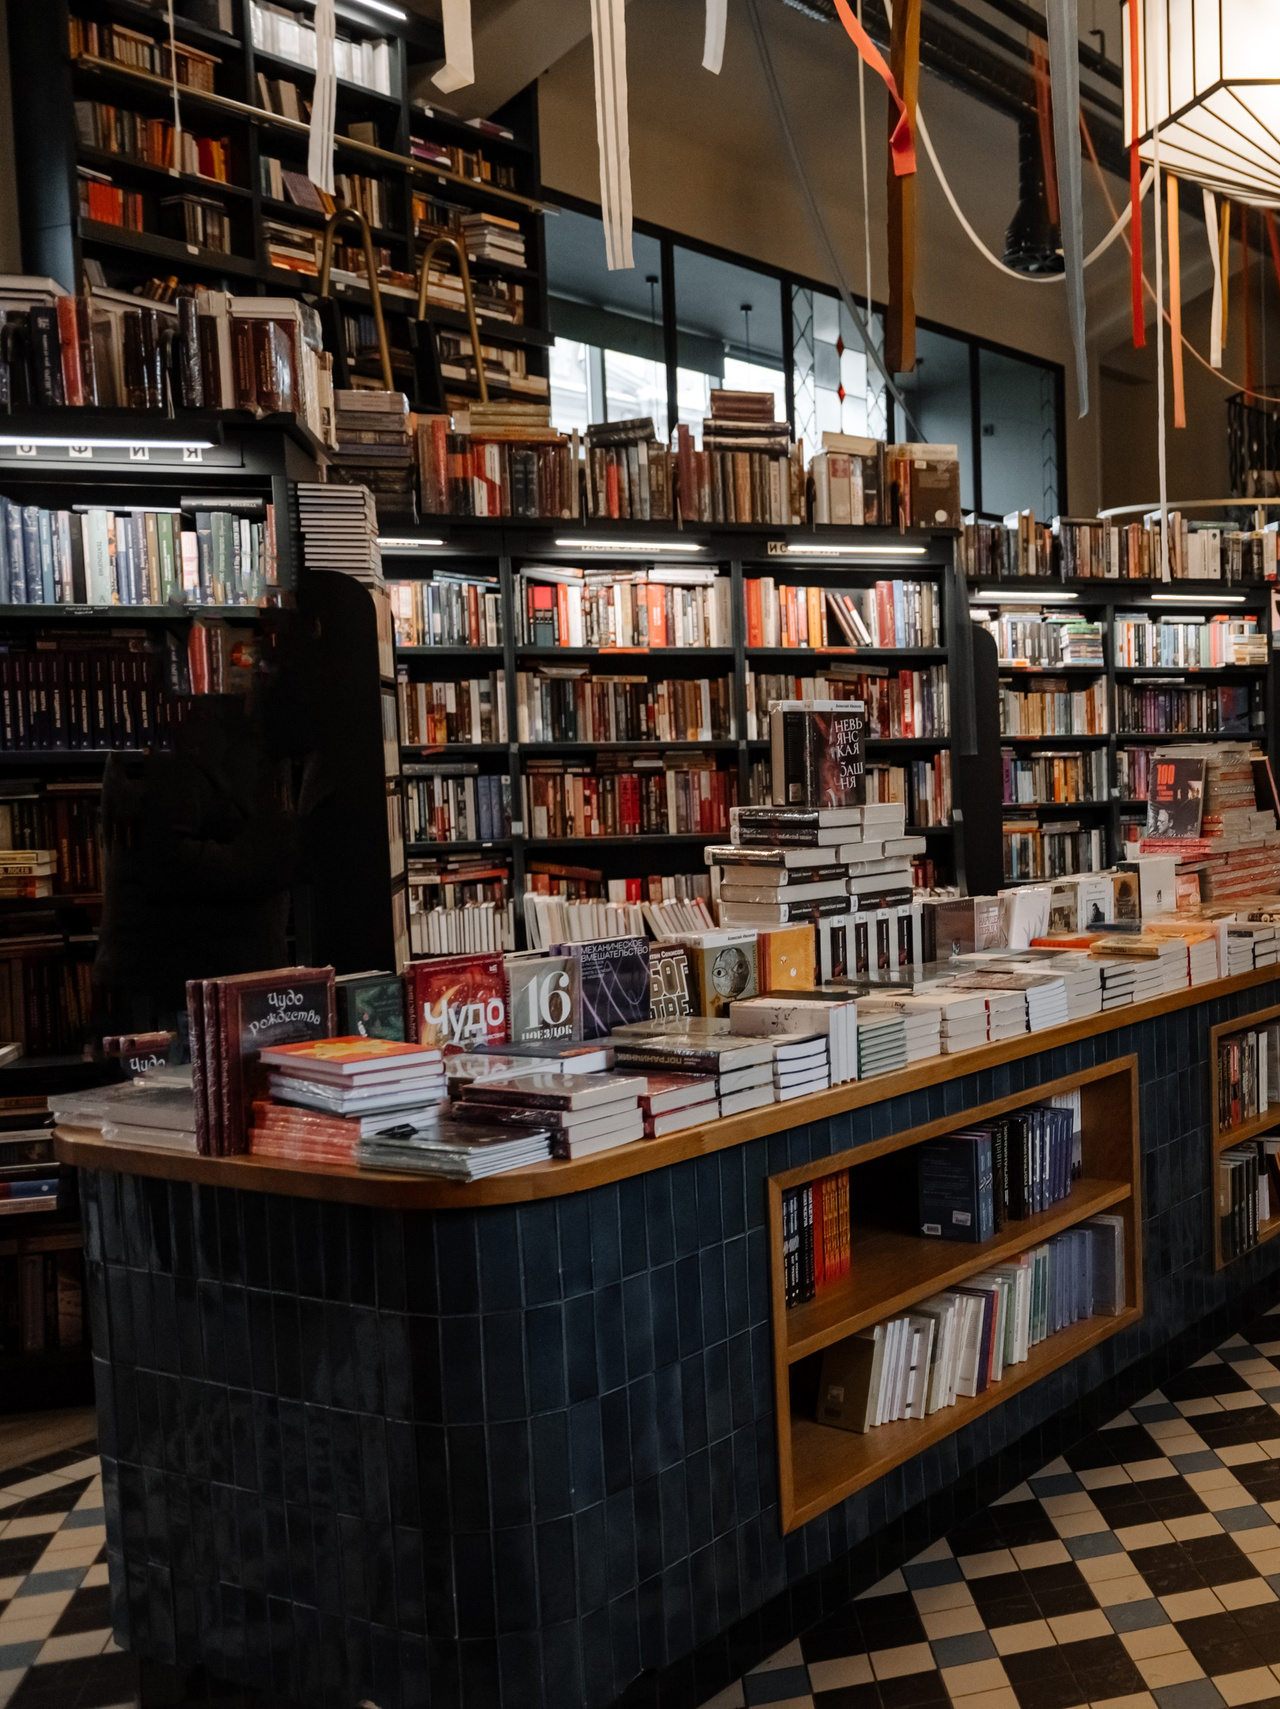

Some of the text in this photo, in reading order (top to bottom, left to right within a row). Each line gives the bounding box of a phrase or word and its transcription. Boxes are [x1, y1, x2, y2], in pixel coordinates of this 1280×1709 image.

[834, 717, 863, 732] НЕВЬ
[836, 730, 860, 745] ЯНС
[836, 743, 860, 758] КАЯ
[1156, 764, 1176, 785] 100
[581, 938, 643, 955] МЕХАНИЧЕСКОЕ
[581, 946, 649, 963] ВМЕШАТЕЛЬСТВО
[661, 948, 685, 958] Секисов
[267, 989, 304, 1010] Чудо
[521, 970, 572, 1030] 16
[248, 1008, 321, 1036] рождества
[423, 997, 505, 1044] Чудо
[521, 1024, 573, 1041] ПОЕЗДОК
[617, 1052, 682, 1065] ПОГРАНИЧНИК
